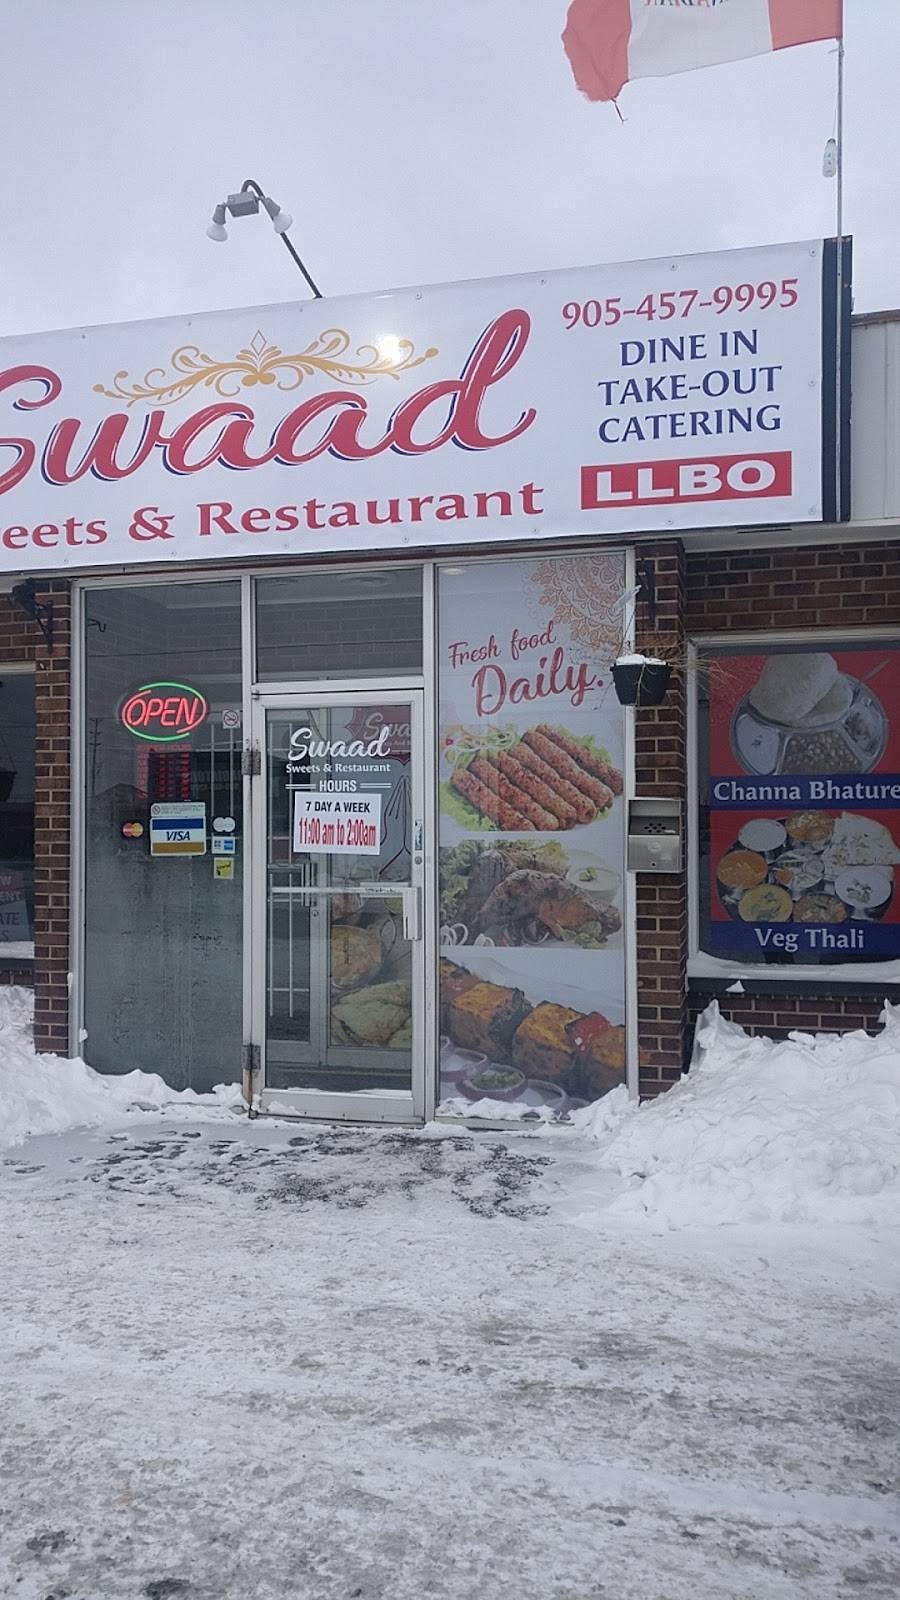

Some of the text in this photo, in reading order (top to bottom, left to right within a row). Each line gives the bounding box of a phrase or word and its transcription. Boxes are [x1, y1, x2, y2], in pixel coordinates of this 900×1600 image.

[562, 278, 799, 330] 905-457-9995
[619, 329, 758, 366] DINE IN
[598, 365, 783, 406] TAKE-OUT
[598, 404, 782, 444] CATERING
[596, 459, 776, 502] LLBO
[128, 506, 176, 542] &
[196, 482, 545, 536] Restaurant
[448, 620, 557, 669] Fresh food
[126, 697, 200, 727] OPEN
[287, 726, 391, 762] Swaad
[286, 763, 391, 773] Sweets & Restaurant
[319, 780, 357, 792] HOURS
[713, 780, 900, 801] Channa Bhature
[305, 801, 371, 813] 7 DAY A WEEK
[166, 831, 191, 841] VISA
[299, 818, 321, 845] 11:00
[322, 824, 335, 845] am
[337, 819, 344, 845] to
[754, 928, 865, 952] Veg Thali
